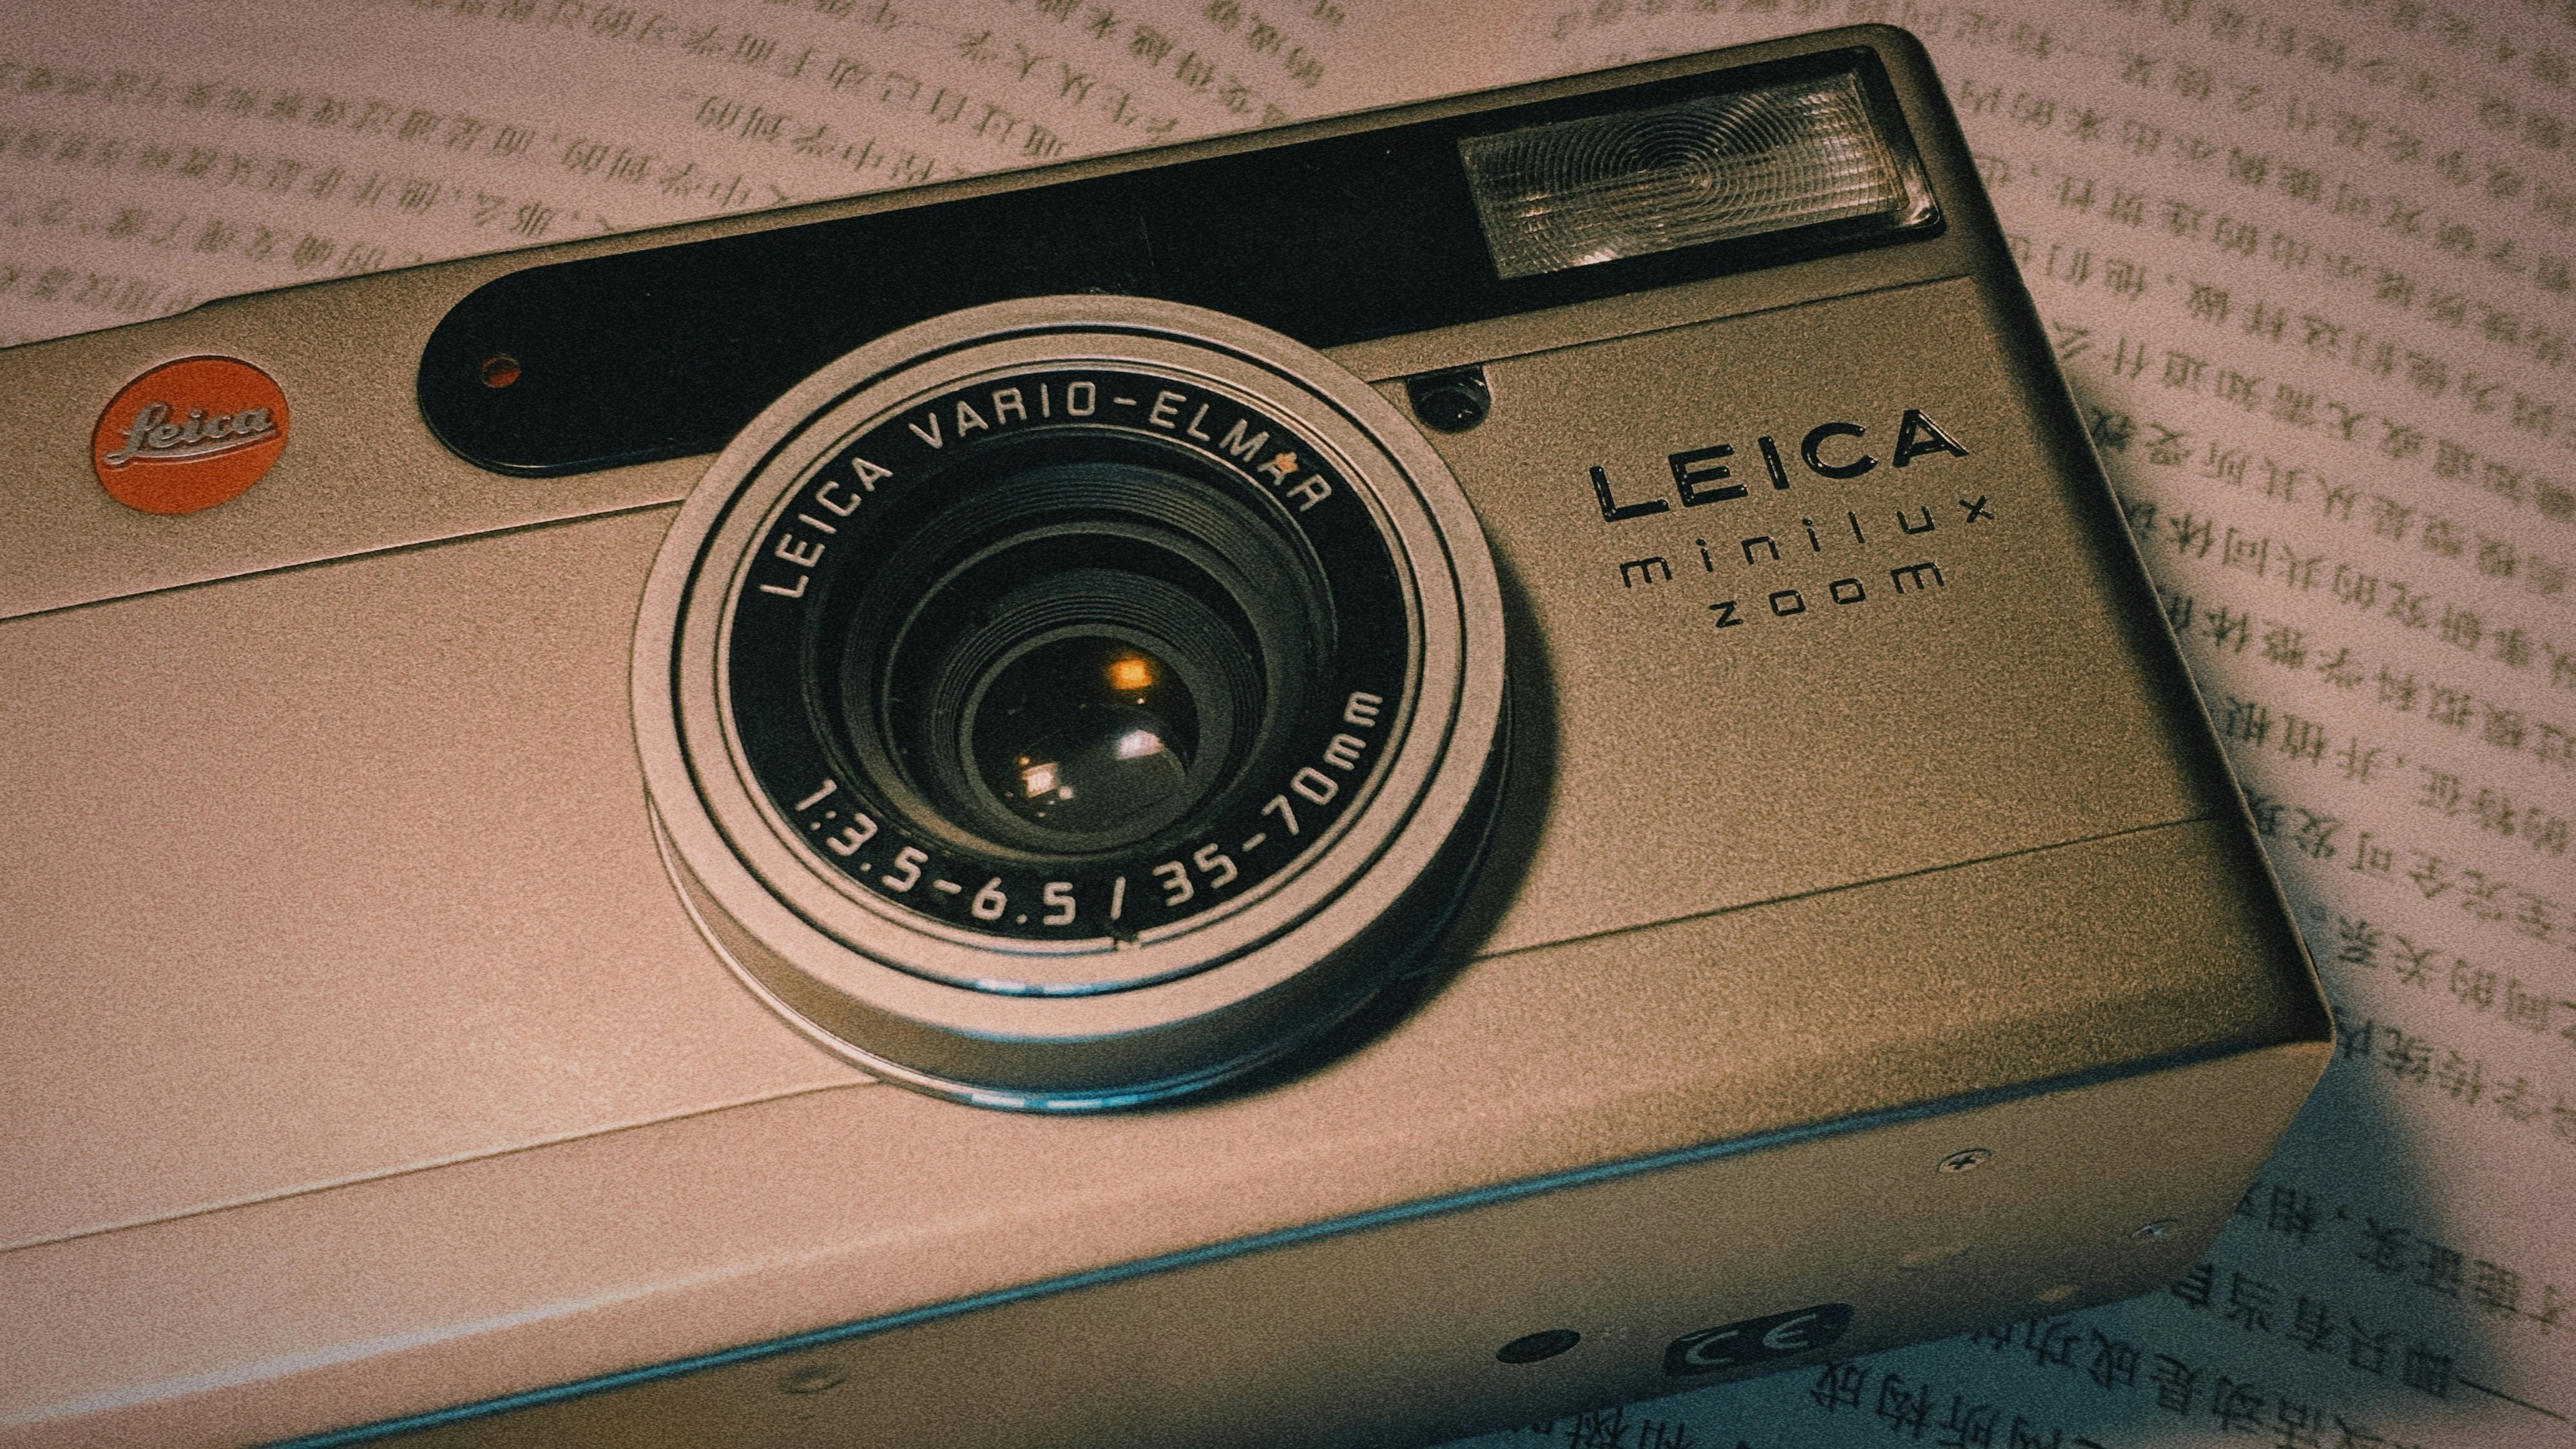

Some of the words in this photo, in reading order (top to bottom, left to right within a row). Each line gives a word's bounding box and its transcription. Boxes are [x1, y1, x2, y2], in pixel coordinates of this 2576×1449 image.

[104, 402, 282, 468] Leica
[1589, 409, 1969, 522] LEICA
[761, 452, 894, 598] LEICA
[909, 382, 1333, 513] VARIO-ELMAR
[1619, 494, 1994, 588] minilux
[1710, 561, 1945, 628] zoom
[796, 780, 1076, 924] 1:3.5-6.5
[1155, 690, 1383, 908] 35-70mm
[2238, 785, 2576, 953] 至完全可发现
[1685, 1313, 1817, 1365] CE
